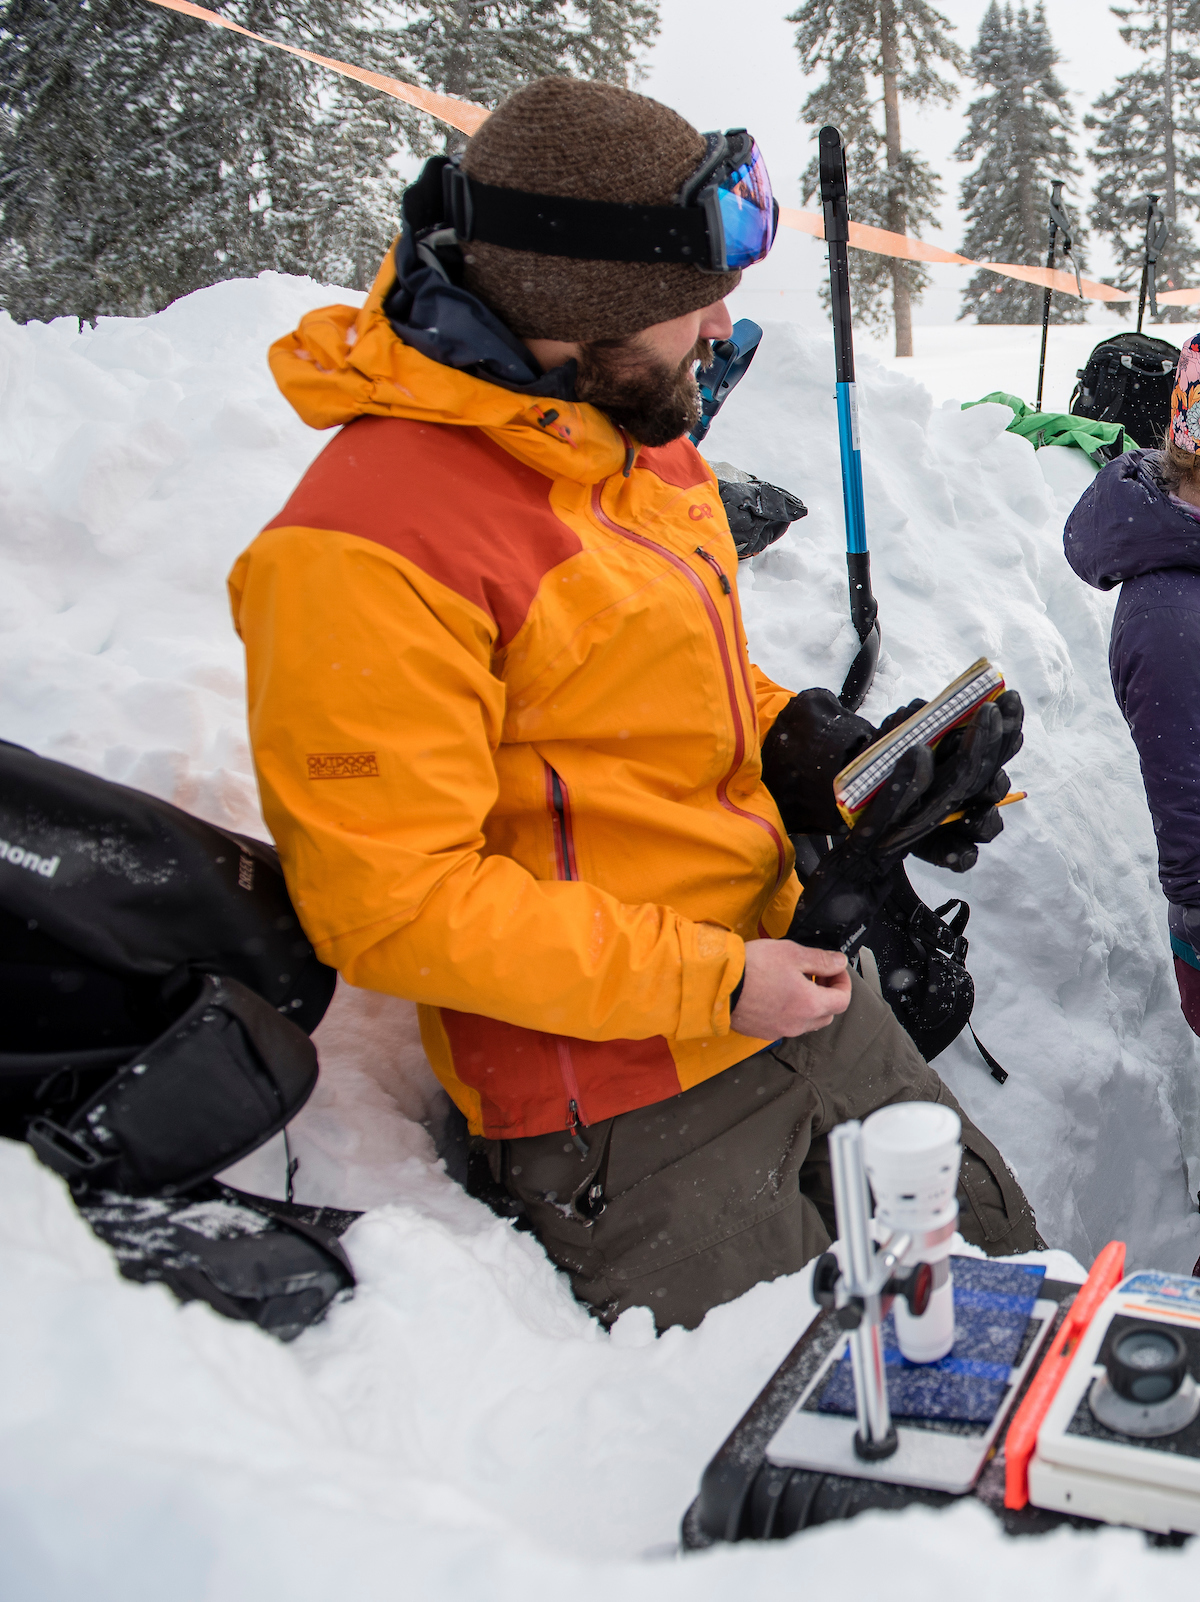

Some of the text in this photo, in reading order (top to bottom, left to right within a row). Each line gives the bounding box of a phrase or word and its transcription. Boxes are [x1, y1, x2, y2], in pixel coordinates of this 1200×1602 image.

[307, 755, 376, 767] OUTDOOR
[308, 762, 378, 776] RESEARCH
[238, 855, 253, 891] CREEK
